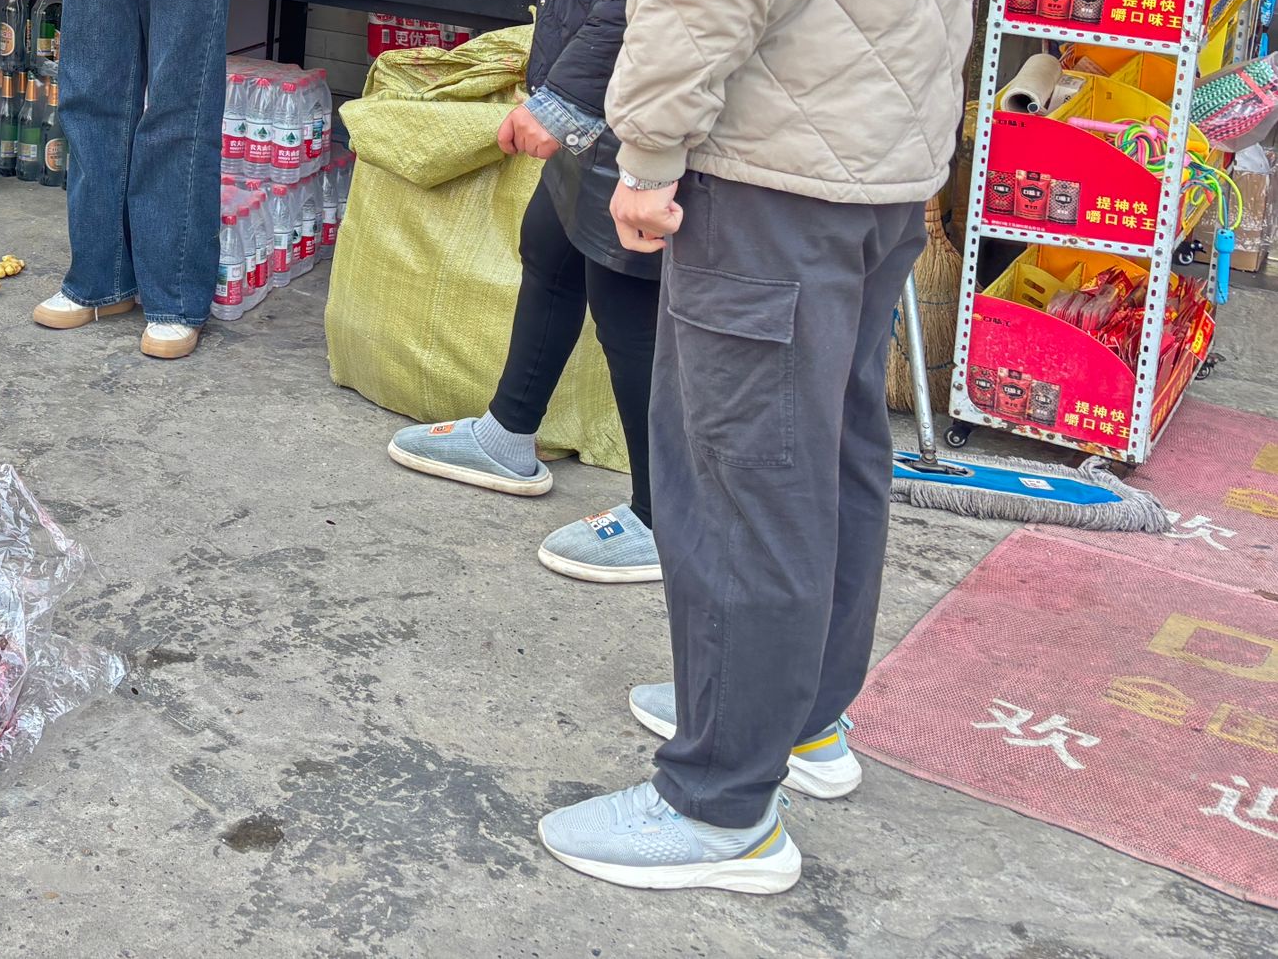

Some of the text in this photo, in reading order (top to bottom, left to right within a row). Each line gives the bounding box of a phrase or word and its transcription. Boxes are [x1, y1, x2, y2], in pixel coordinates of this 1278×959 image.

[1111, 8, 1182, 29] 嚼口味王
[1096, 196, 1148, 216] 提神快
[1085, 210, 1155, 232] 嚼口味王
[1075, 400, 1125, 424] 提神快
[1065, 413, 1131, 439] 嚼口味王
